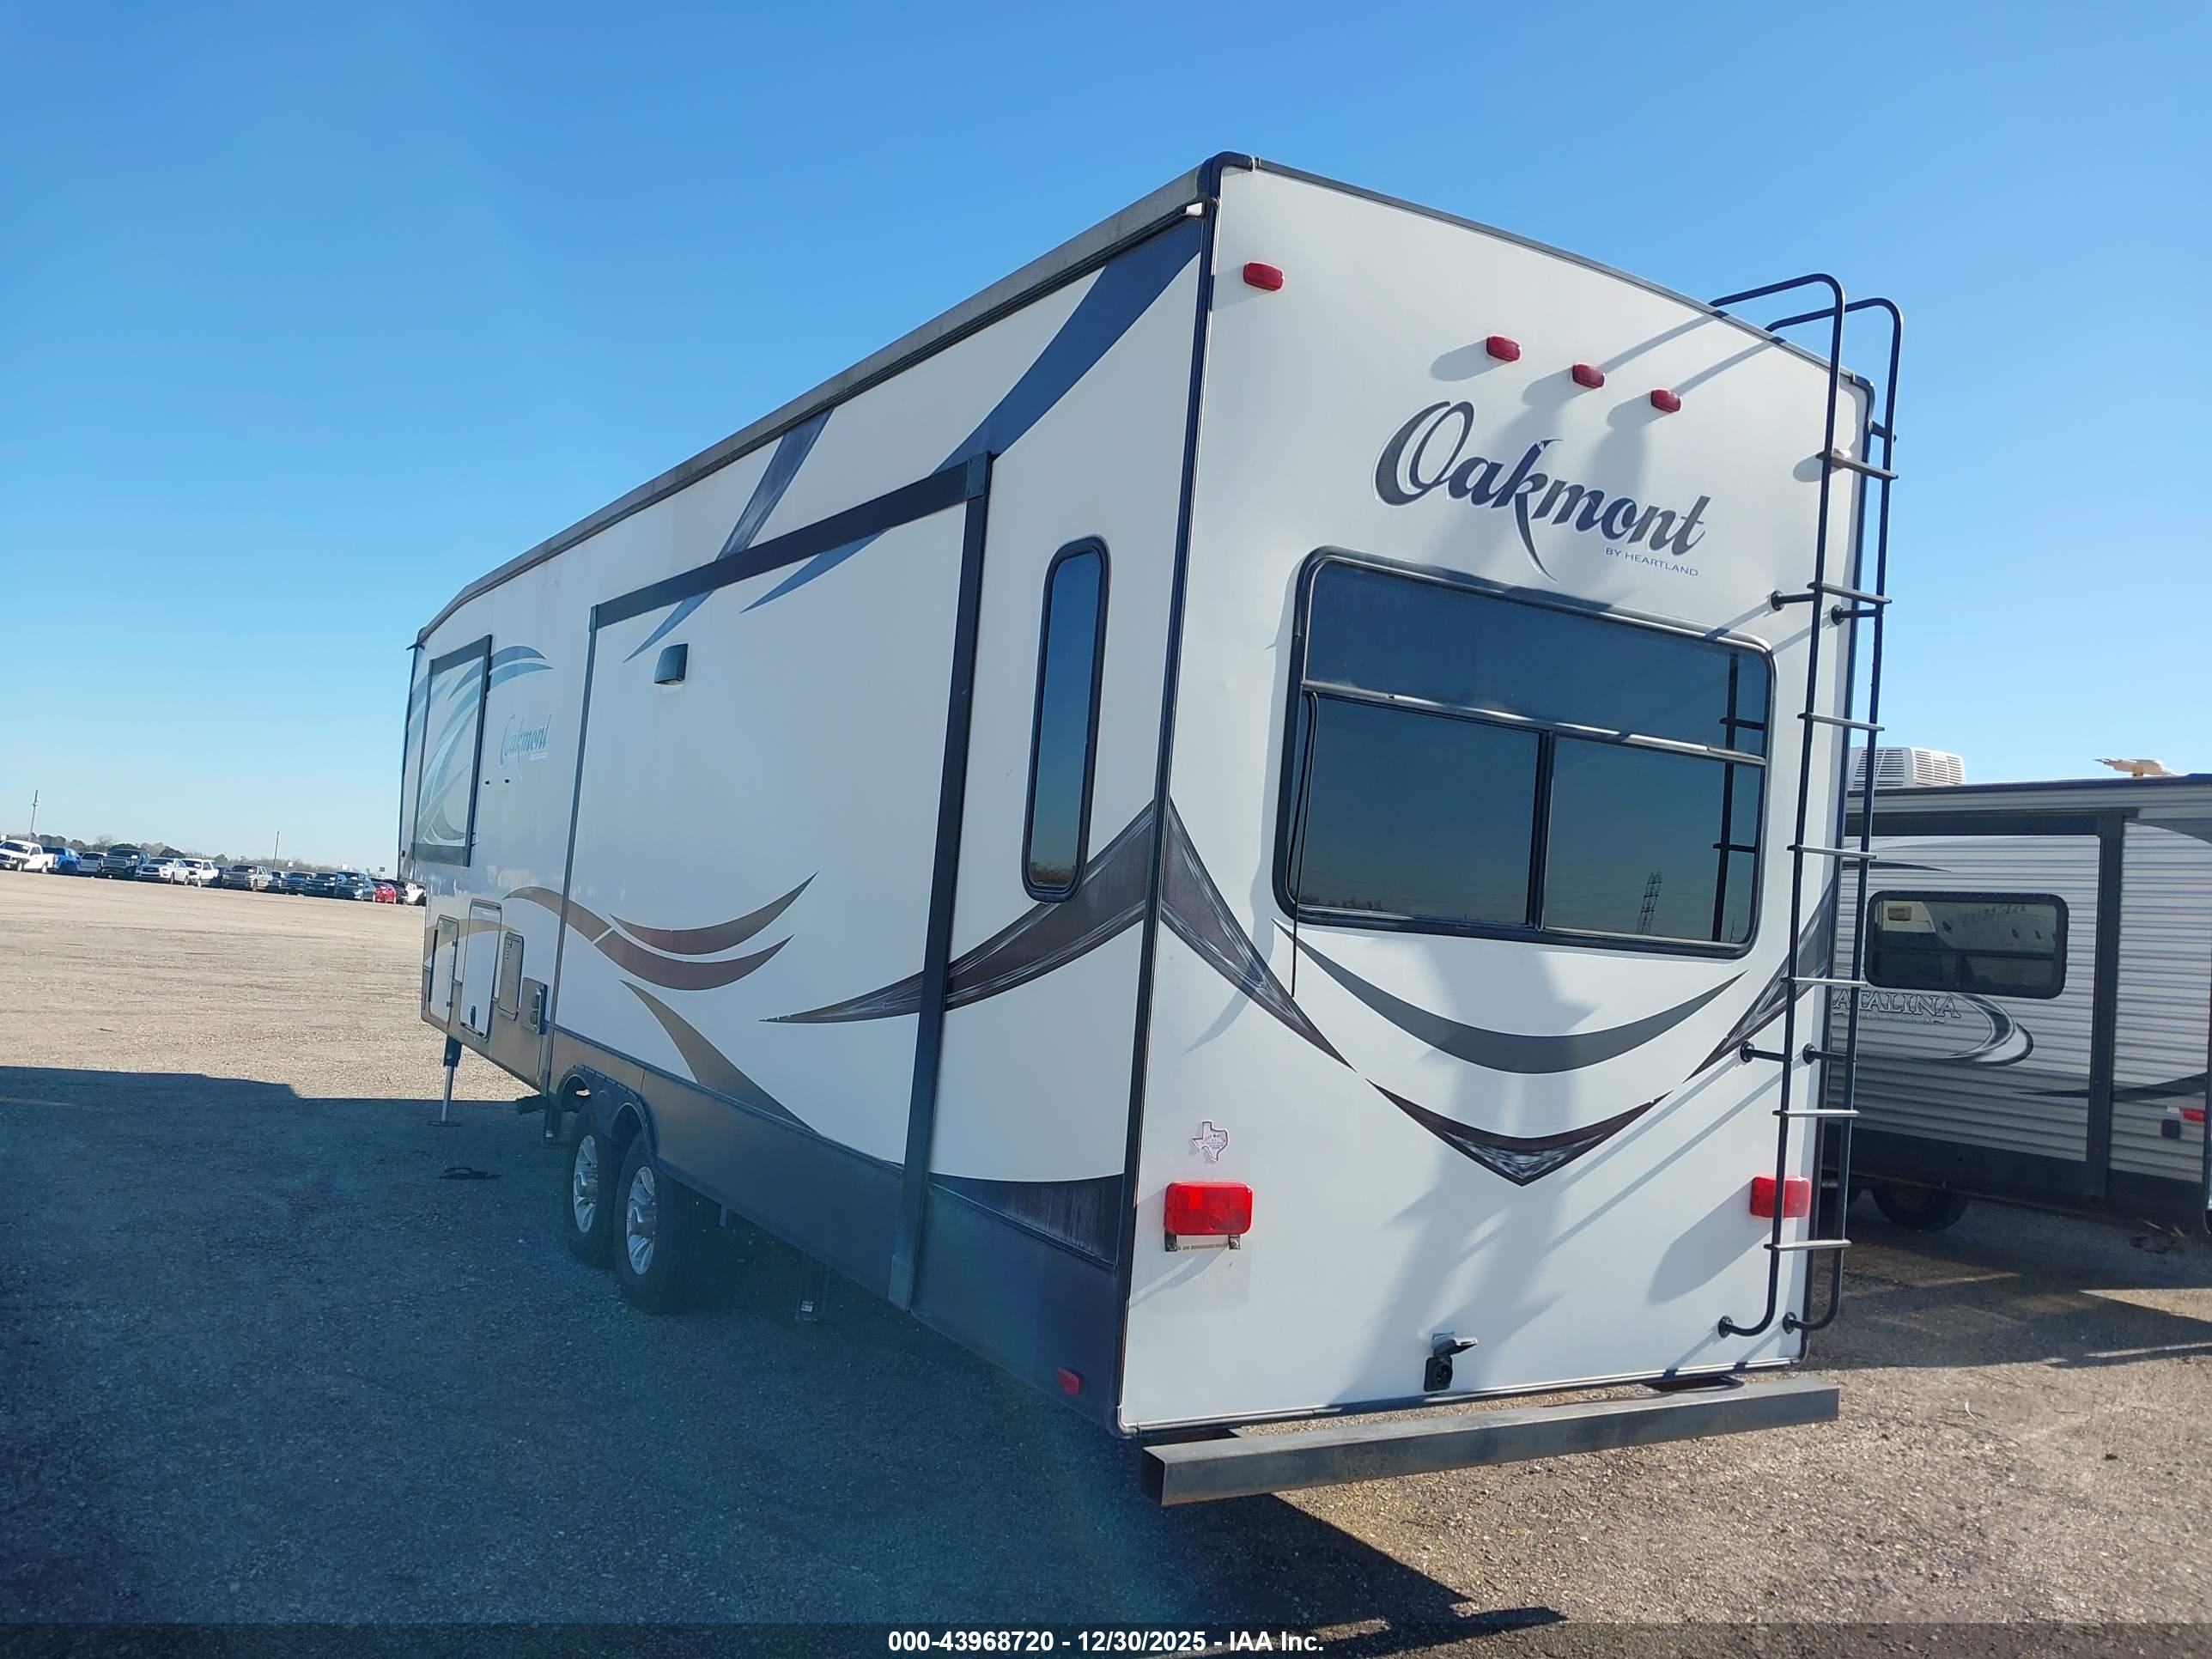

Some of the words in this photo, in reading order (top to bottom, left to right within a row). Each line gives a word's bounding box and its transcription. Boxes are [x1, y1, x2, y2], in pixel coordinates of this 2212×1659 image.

[1374, 399, 1712, 583] Oakmont
[1605, 547, 1622, 557] BY
[1625, 551, 1699, 577] HEARTLAND
[1832, 988, 1962, 1018] ATALINA
